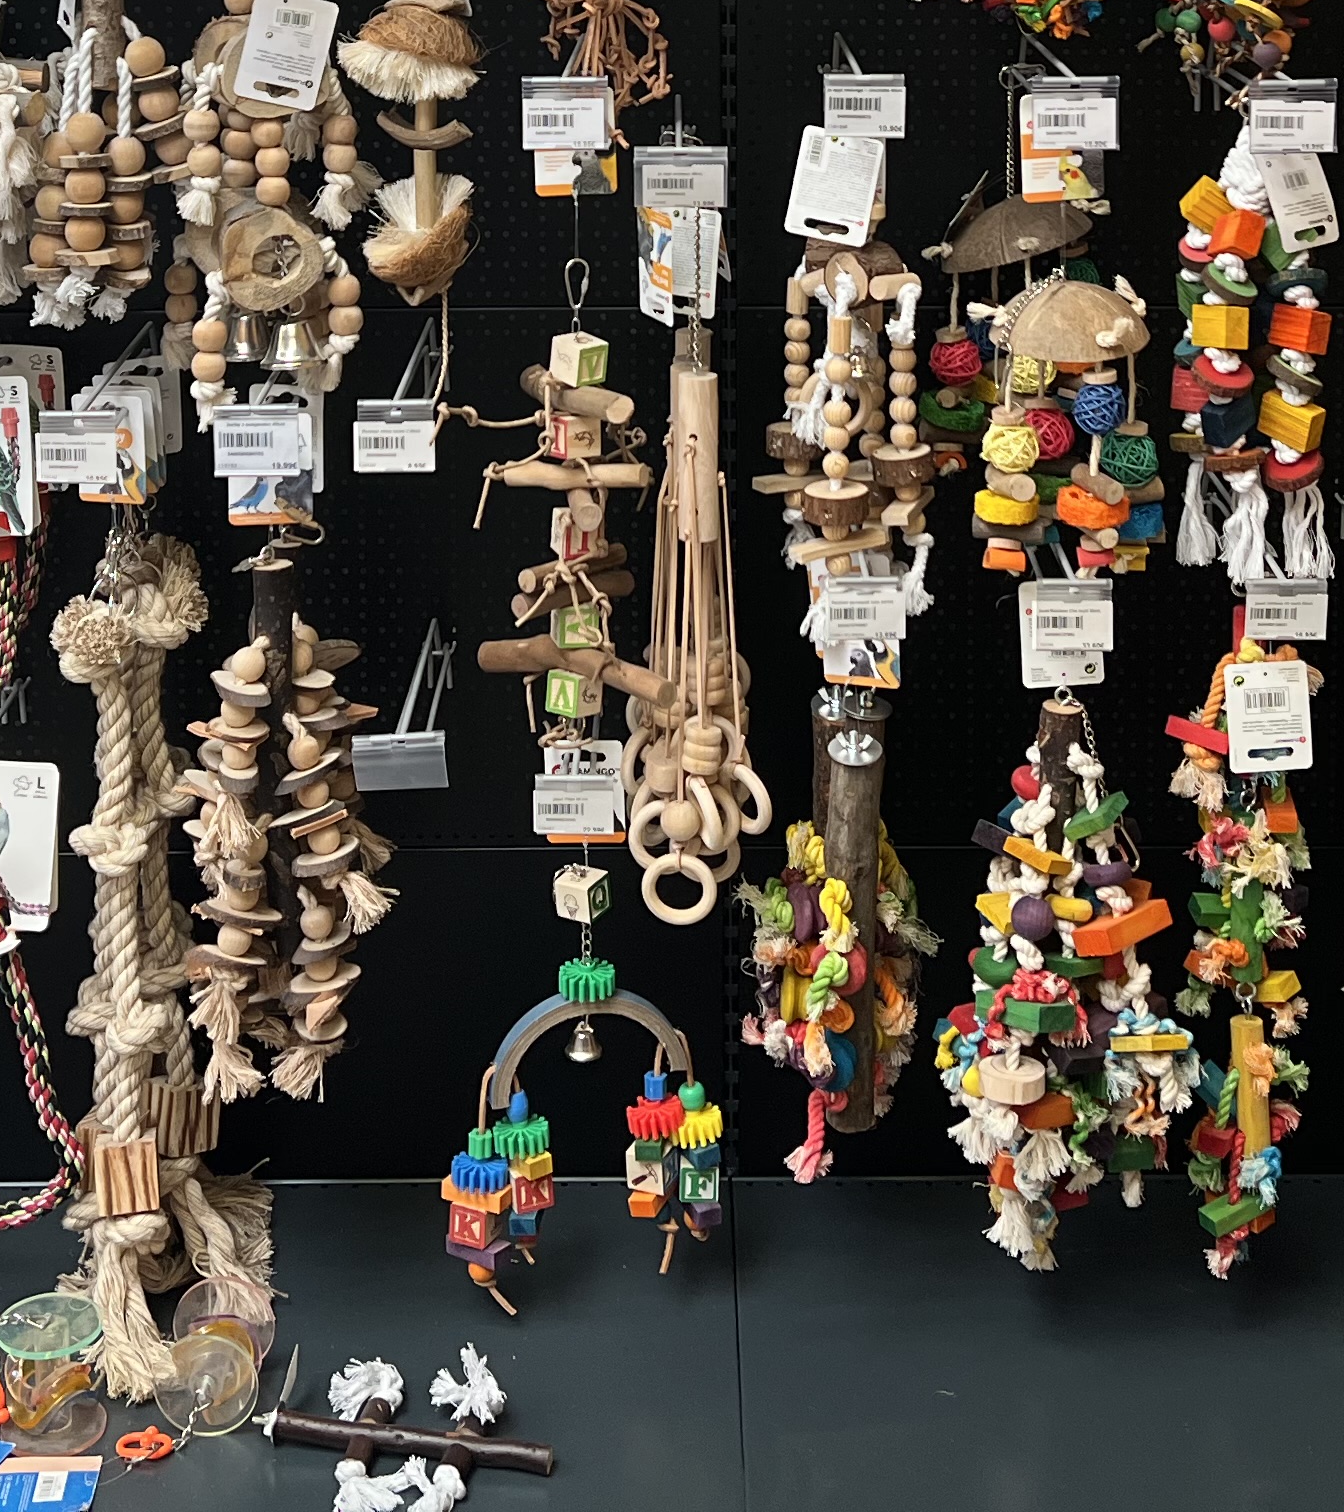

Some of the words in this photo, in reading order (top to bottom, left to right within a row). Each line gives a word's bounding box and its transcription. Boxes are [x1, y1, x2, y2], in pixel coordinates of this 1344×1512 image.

[46, 354, 54, 366] S
[10, 385, 18, 396] S
[37, 776, 45, 789] L
